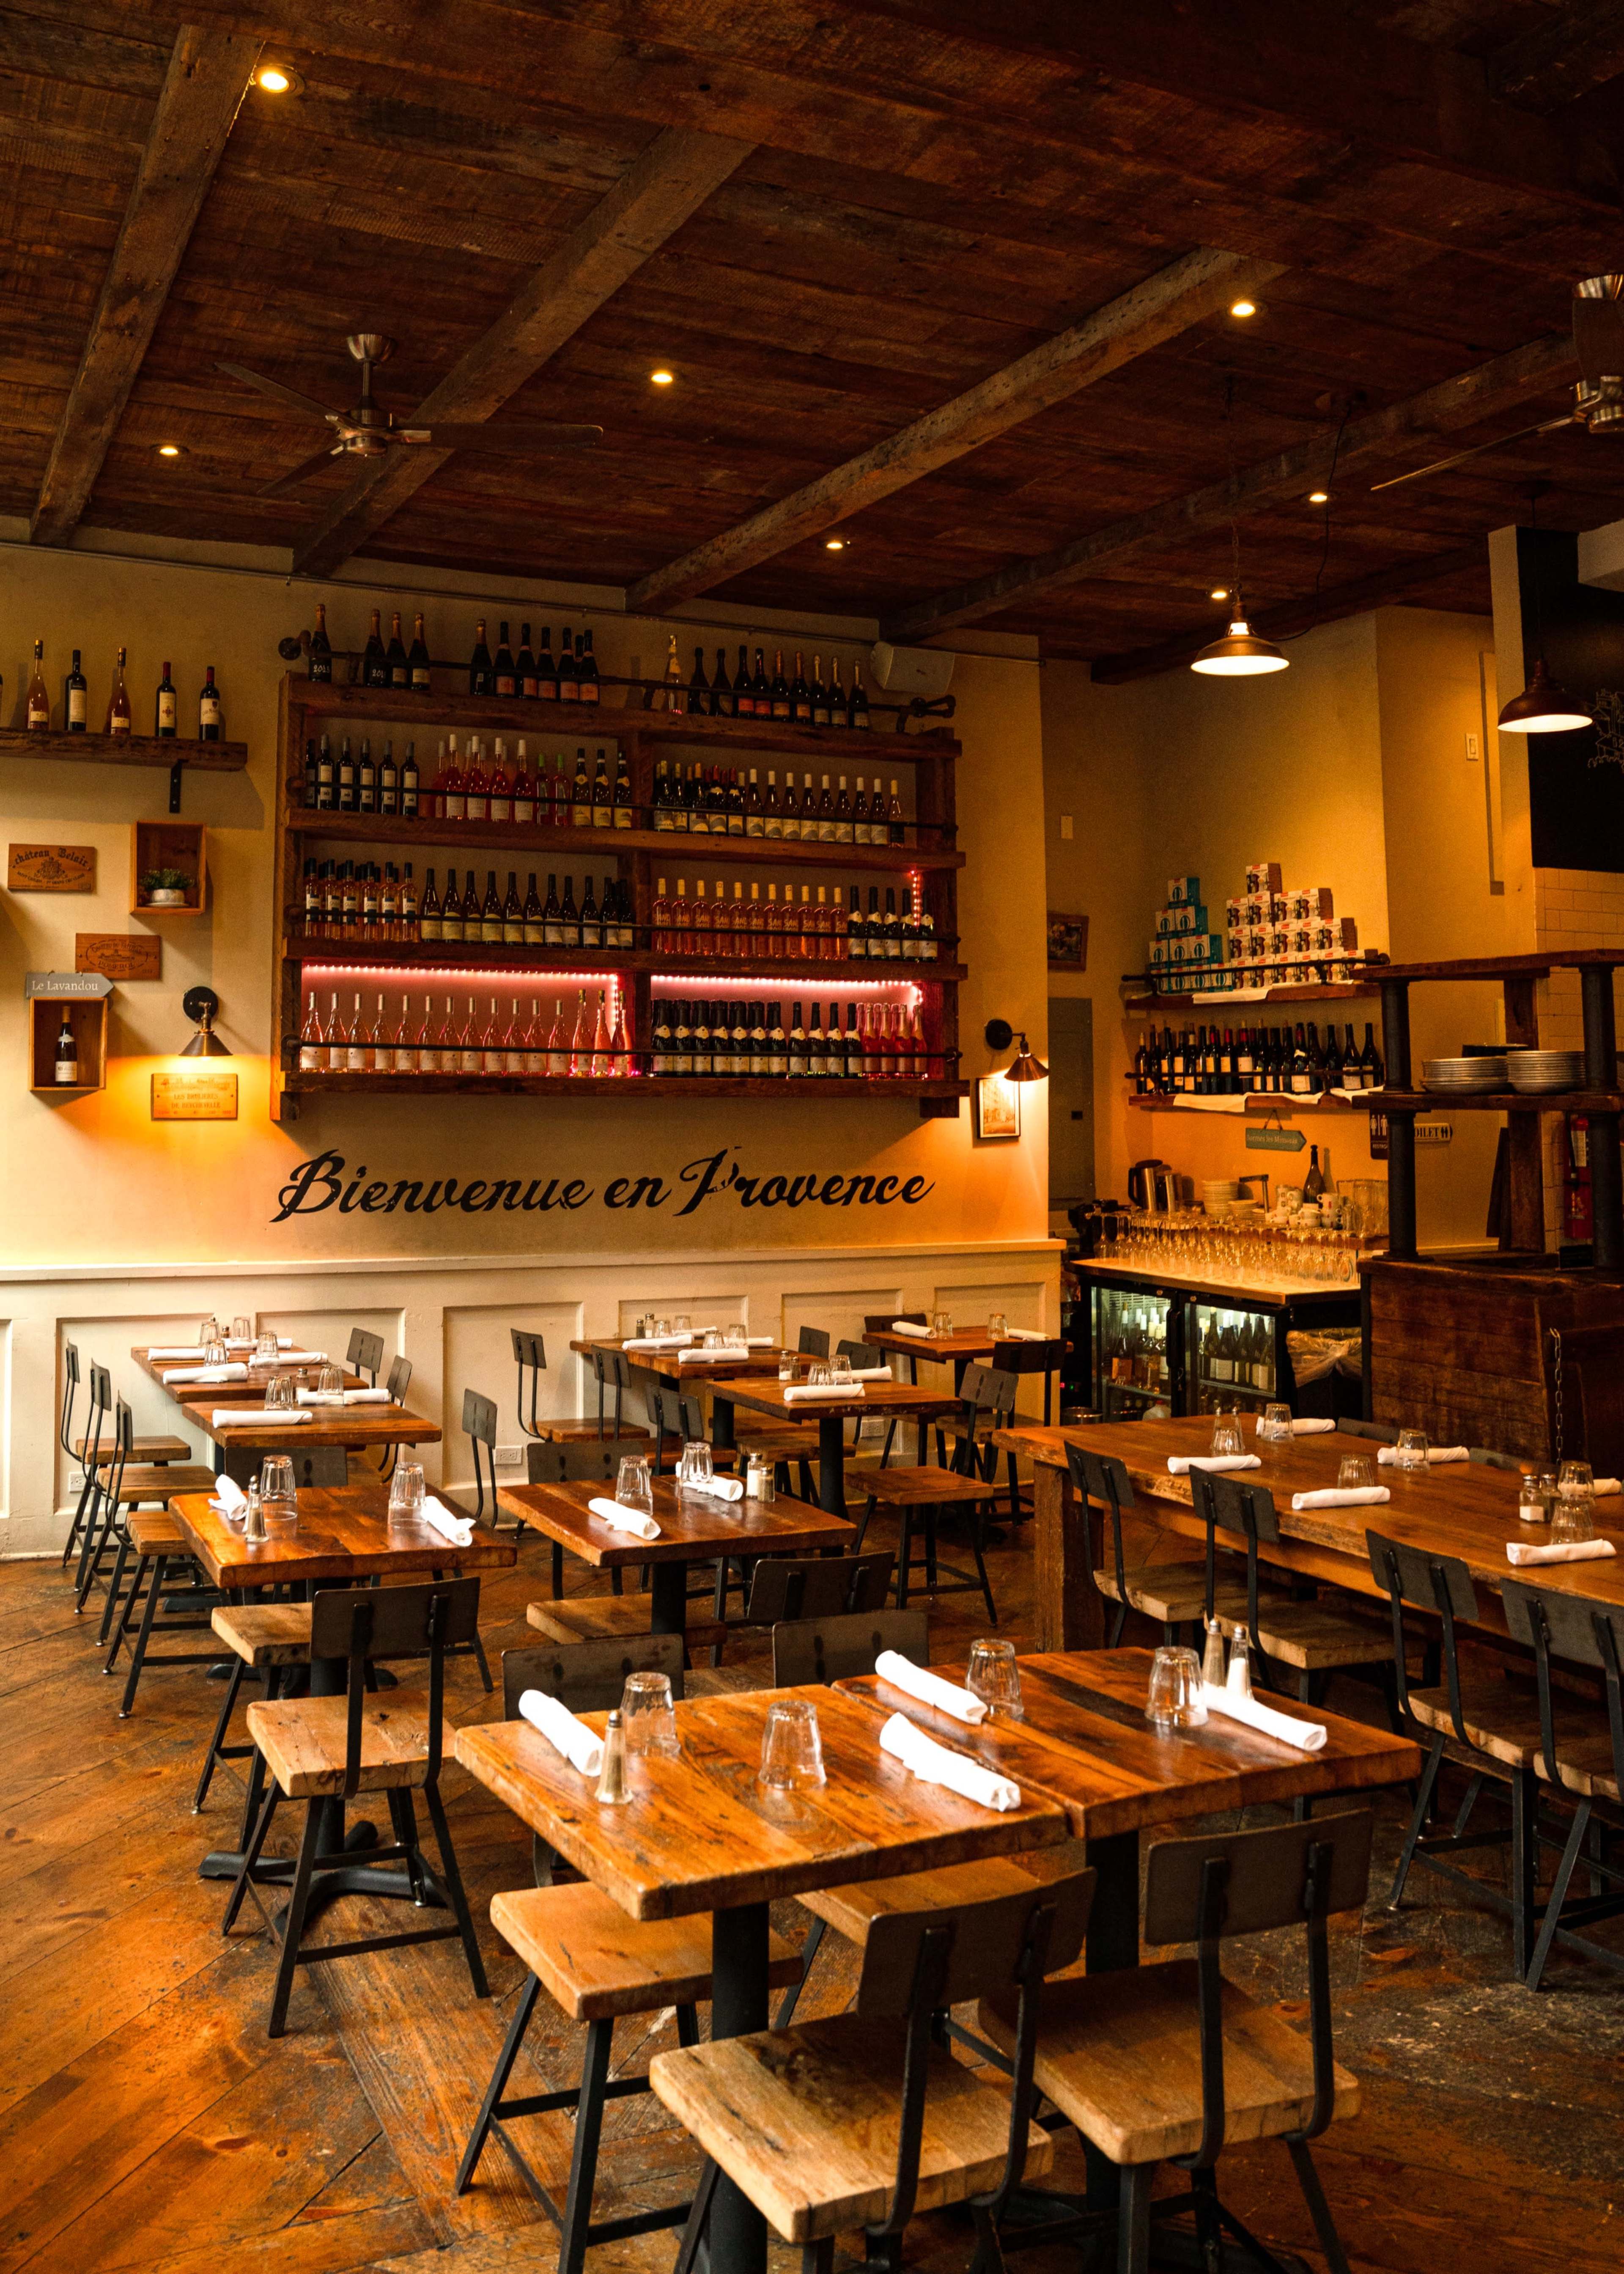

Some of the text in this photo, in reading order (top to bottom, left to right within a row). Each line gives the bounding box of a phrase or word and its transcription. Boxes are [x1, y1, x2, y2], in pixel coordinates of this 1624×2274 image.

[58, 847, 88, 867] Belair
[98, 961, 133, 969] POMEROL
[32, 980, 99, 991] Le Lavandou
[1414, 1127, 1439, 1137] OILET
[268, 1146, 936, 1223] Bienvenue en Provence
